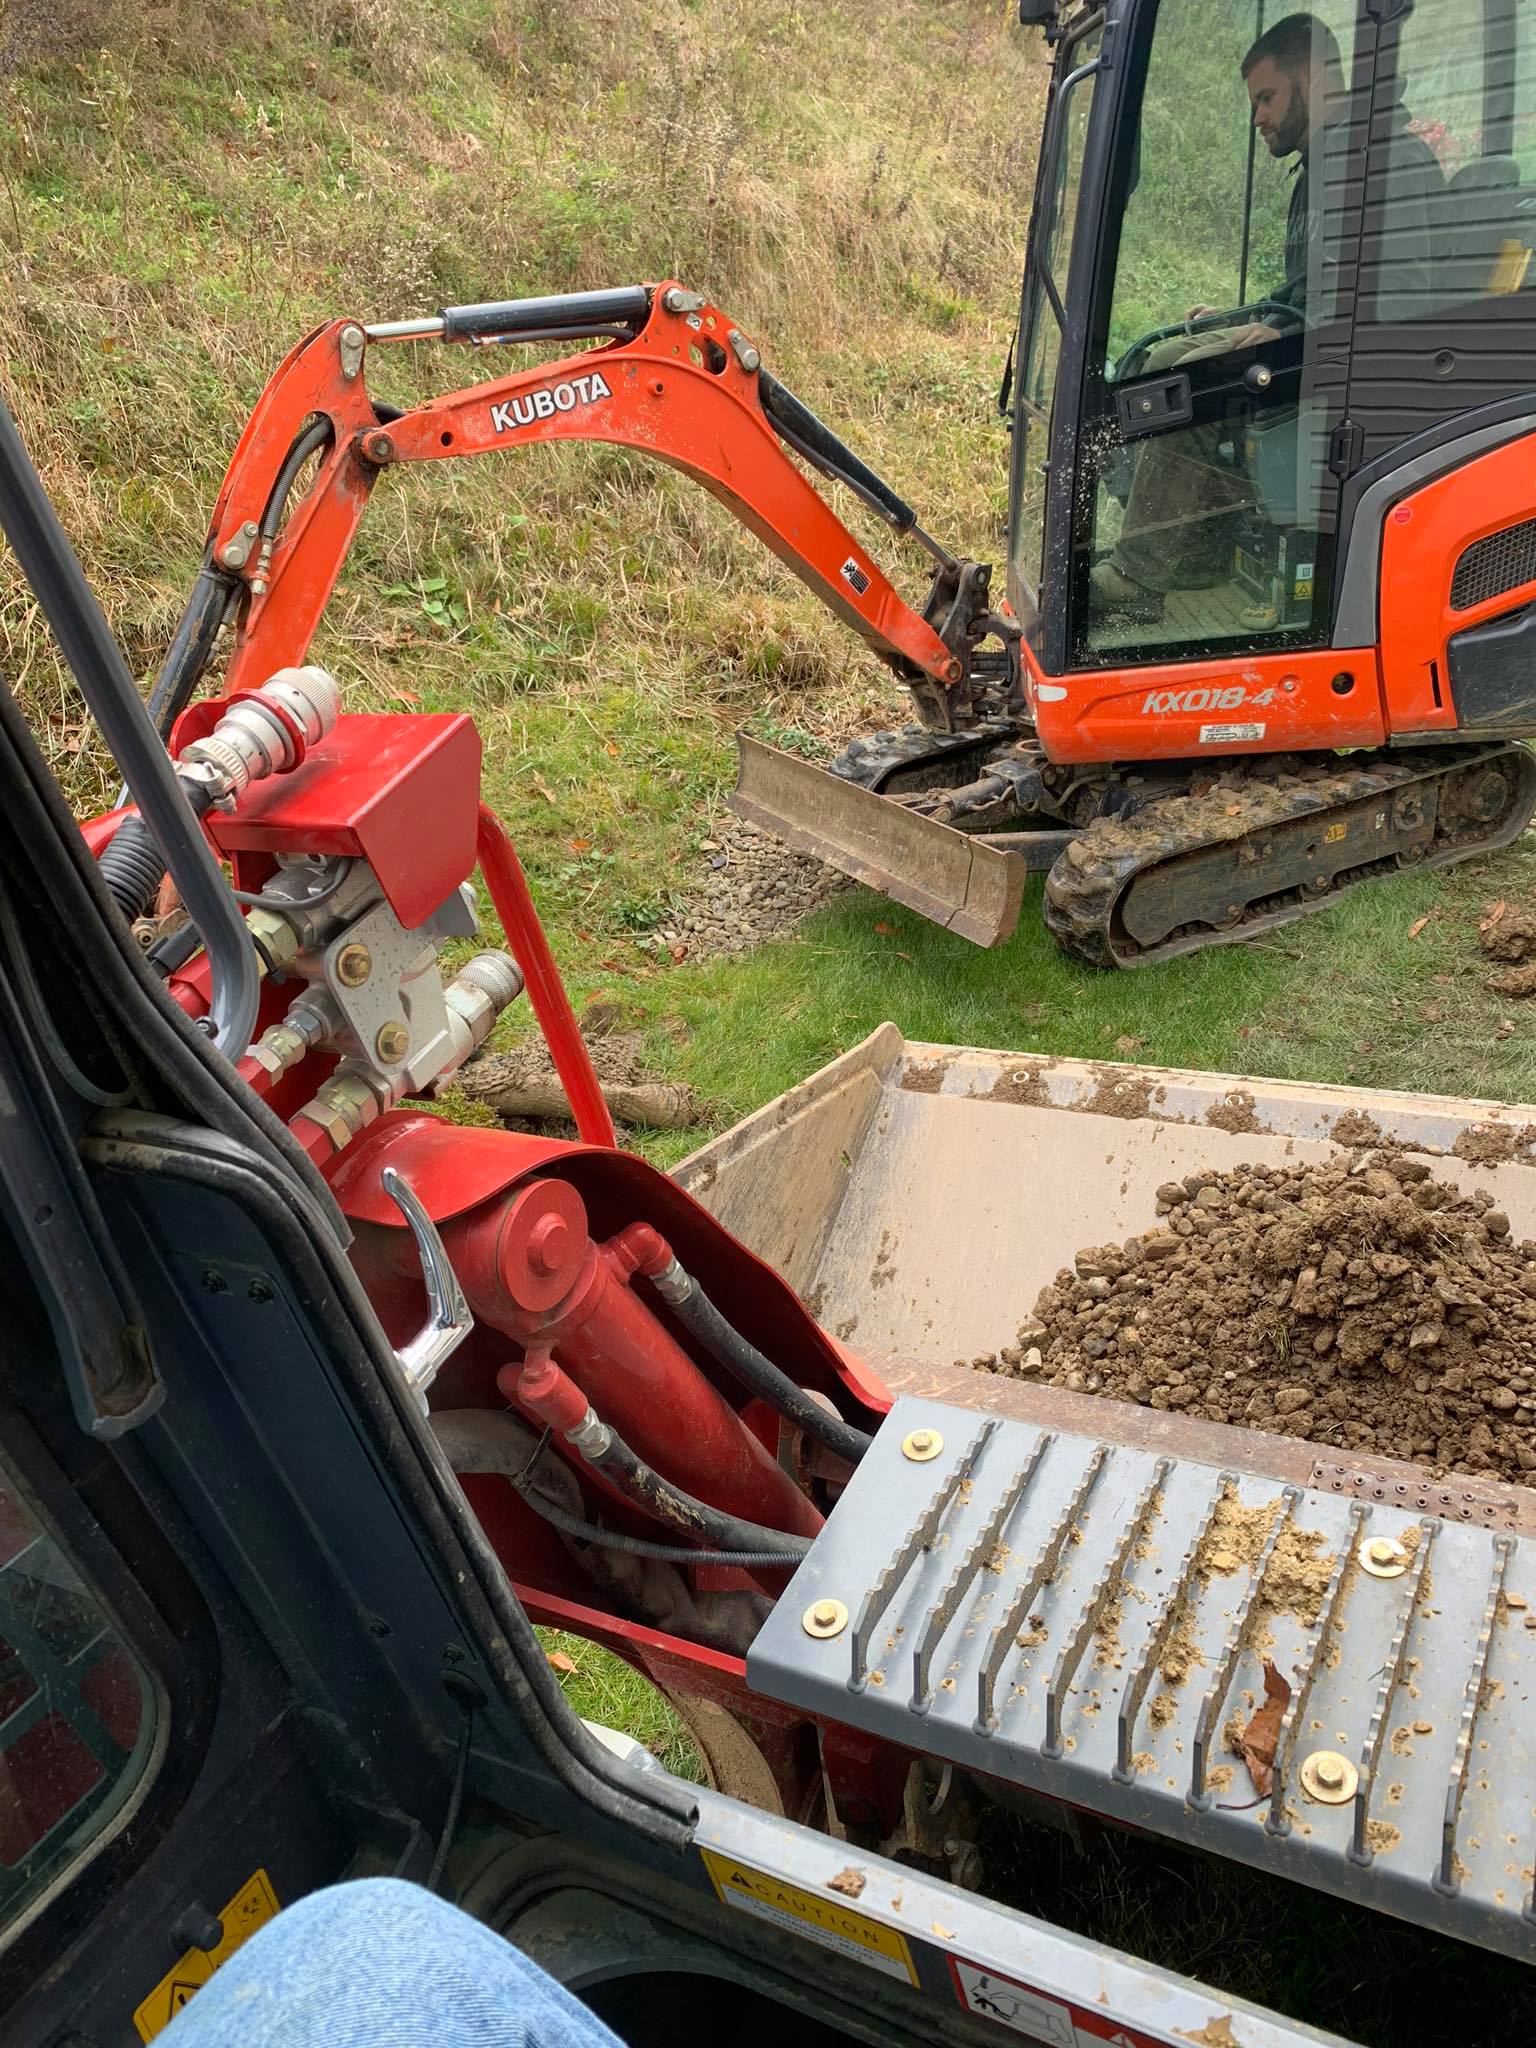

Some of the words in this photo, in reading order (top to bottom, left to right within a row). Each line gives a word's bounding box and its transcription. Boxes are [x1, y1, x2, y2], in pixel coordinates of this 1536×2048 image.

[490, 372, 612, 432] KUBOTA
[1141, 686, 1275, 714] KX018-4
[755, 1883, 879, 1943] CAUTION
